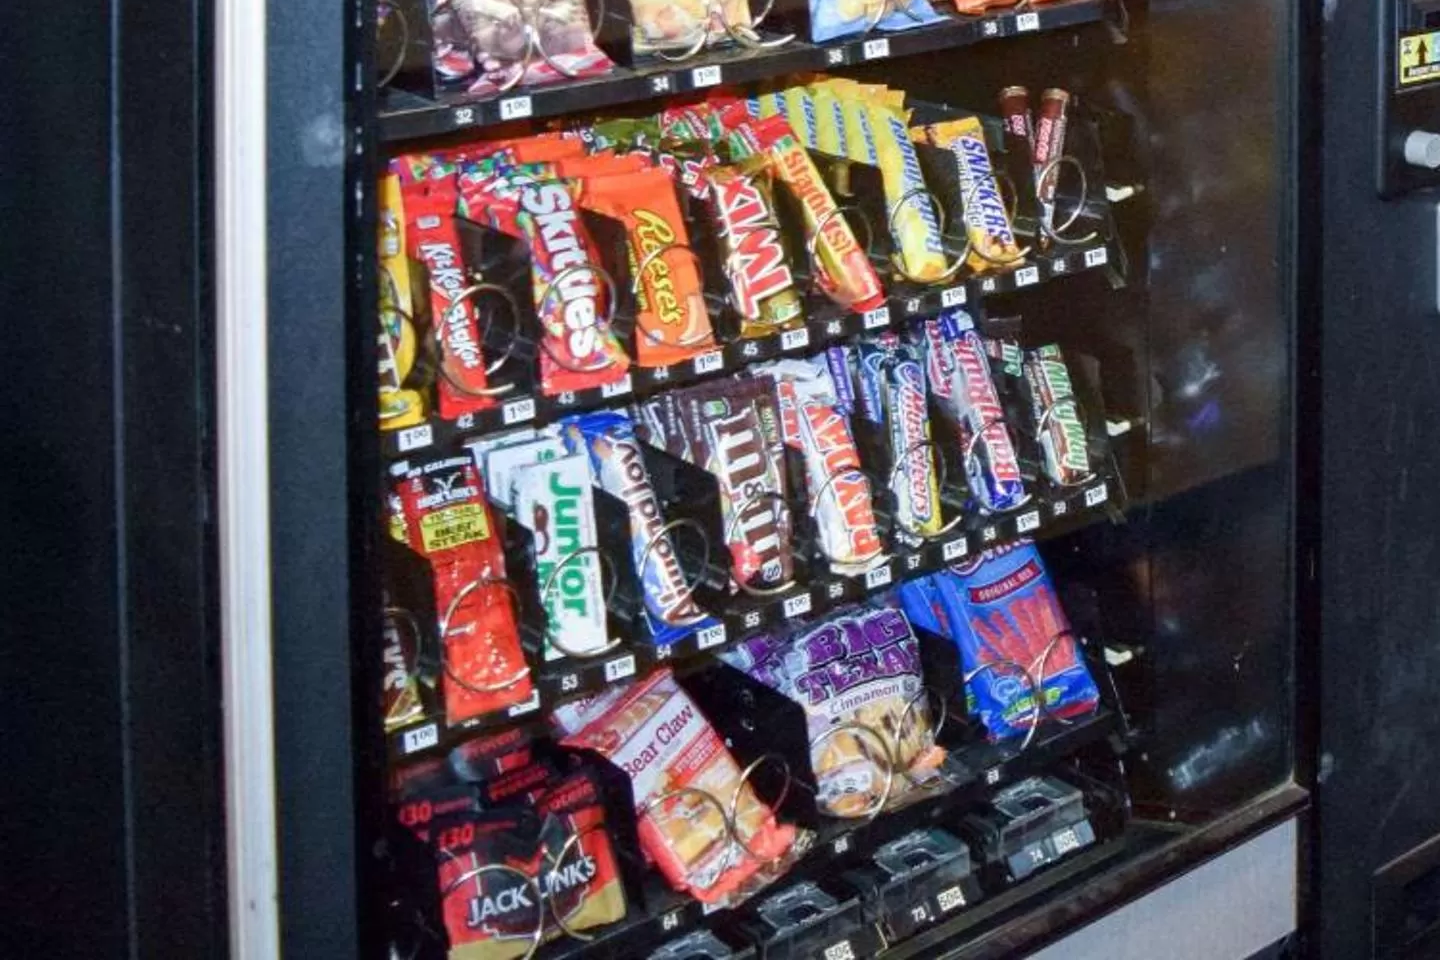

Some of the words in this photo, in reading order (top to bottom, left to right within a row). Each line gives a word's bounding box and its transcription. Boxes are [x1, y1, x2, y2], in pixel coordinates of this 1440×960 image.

[653, 76, 670, 91] 34
[455, 108, 473, 124] 32
[961, 135, 1015, 248] SNICKERS
[711, 176, 793, 321] TWIX
[521, 186, 597, 359] Skittles
[631, 208, 684, 326] Reese's
[907, 299, 921, 313] 47
[742, 342, 759, 356] 45
[457, 414, 474, 429] 42
[899, 384, 934, 518] Musketeers
[550, 471, 588, 617] Junior
[907, 554, 921, 568] 57
[634, 505, 709, 625] Almond
[745, 612, 760, 627] 55
[656, 644, 672, 659] 54
[804, 609, 911, 670] BIG
[562, 674, 578, 690] 53
[829, 682, 901, 716] Cinnamon
[623, 741, 661, 779] Bear
[655, 704, 695, 746] Claw
[467, 883, 533, 928] JACK
[911, 906, 927, 922] 73
